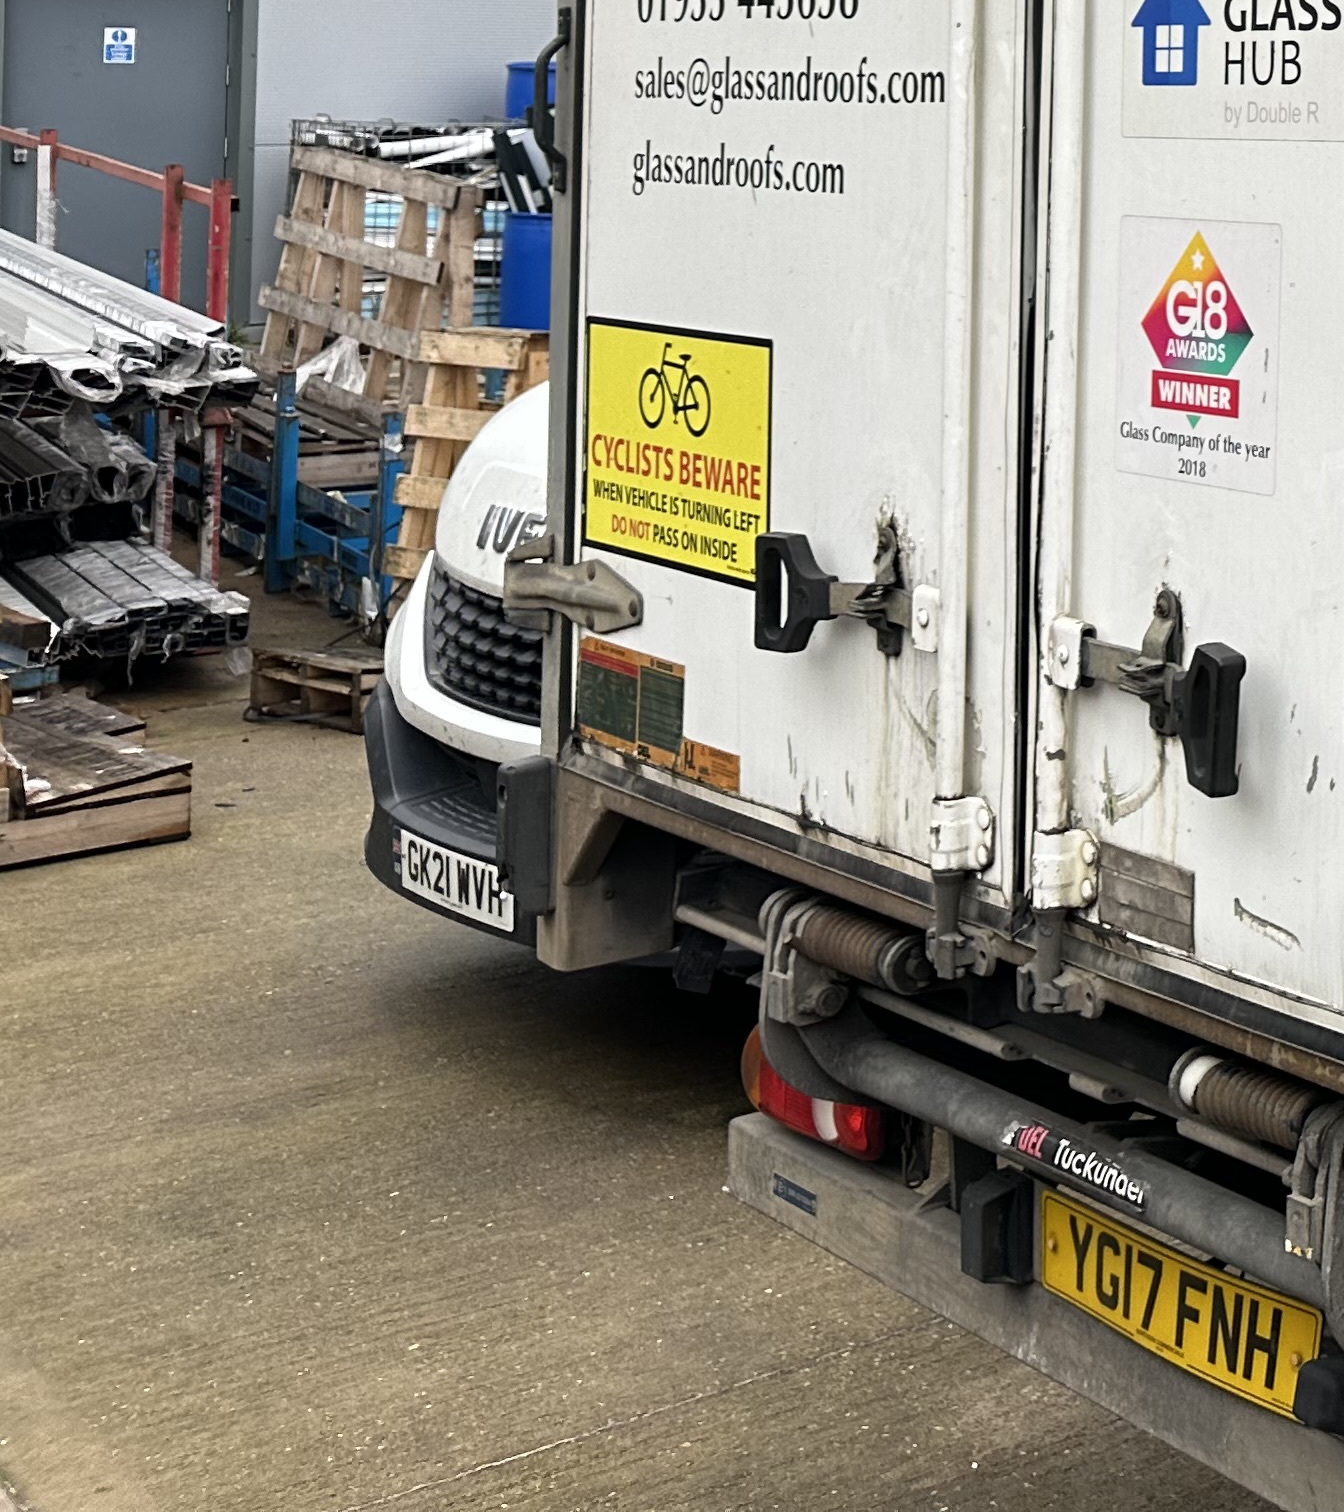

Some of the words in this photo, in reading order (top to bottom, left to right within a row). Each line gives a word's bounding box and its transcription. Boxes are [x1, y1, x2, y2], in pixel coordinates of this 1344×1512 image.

[634, 56, 946, 115] sales@glassandroofs.com
[1224, 40, 1302, 85] HUB
[1224, 102, 1244, 128] by
[1246, 101, 1303, 125] Double
[1306, 102, 1320, 124] R
[632, 139, 845, 196] glassandroofs.com
[1165, 338, 1227, 362] AWARDS
[1158, 378, 1231, 410] WINNER
[1120, 421, 1149, 441] Glass
[1152, 426, 1205, 455] Company
[1208, 434, 1223, 451] of
[1223, 436, 1242, 455] the
[1245, 442, 1270, 462] year
[591, 433, 674, 482] CYCLISTS
[679, 451, 761, 501] BEWARE
[1178, 457, 1207, 478] 2018
[593, 478, 623, 502] WHEN
[625, 485, 667, 513] VEHICLE
[669, 496, 679, 516] IS
[681, 498, 732, 528] TURNING
[733, 510, 761, 535] LEFT
[611, 514, 628, 536] DO
[629, 518, 650, 539] NOT
[652, 524, 679, 548] PASS
[681, 531, 698, 553] ON
[700, 536, 738, 563] INSIDE
[408, 840, 450, 898] GK21
[457, 859, 503, 918] WVH
[1069, 1214, 1163, 1332] YG17
[1174, 1269, 1284, 1392] FNH
